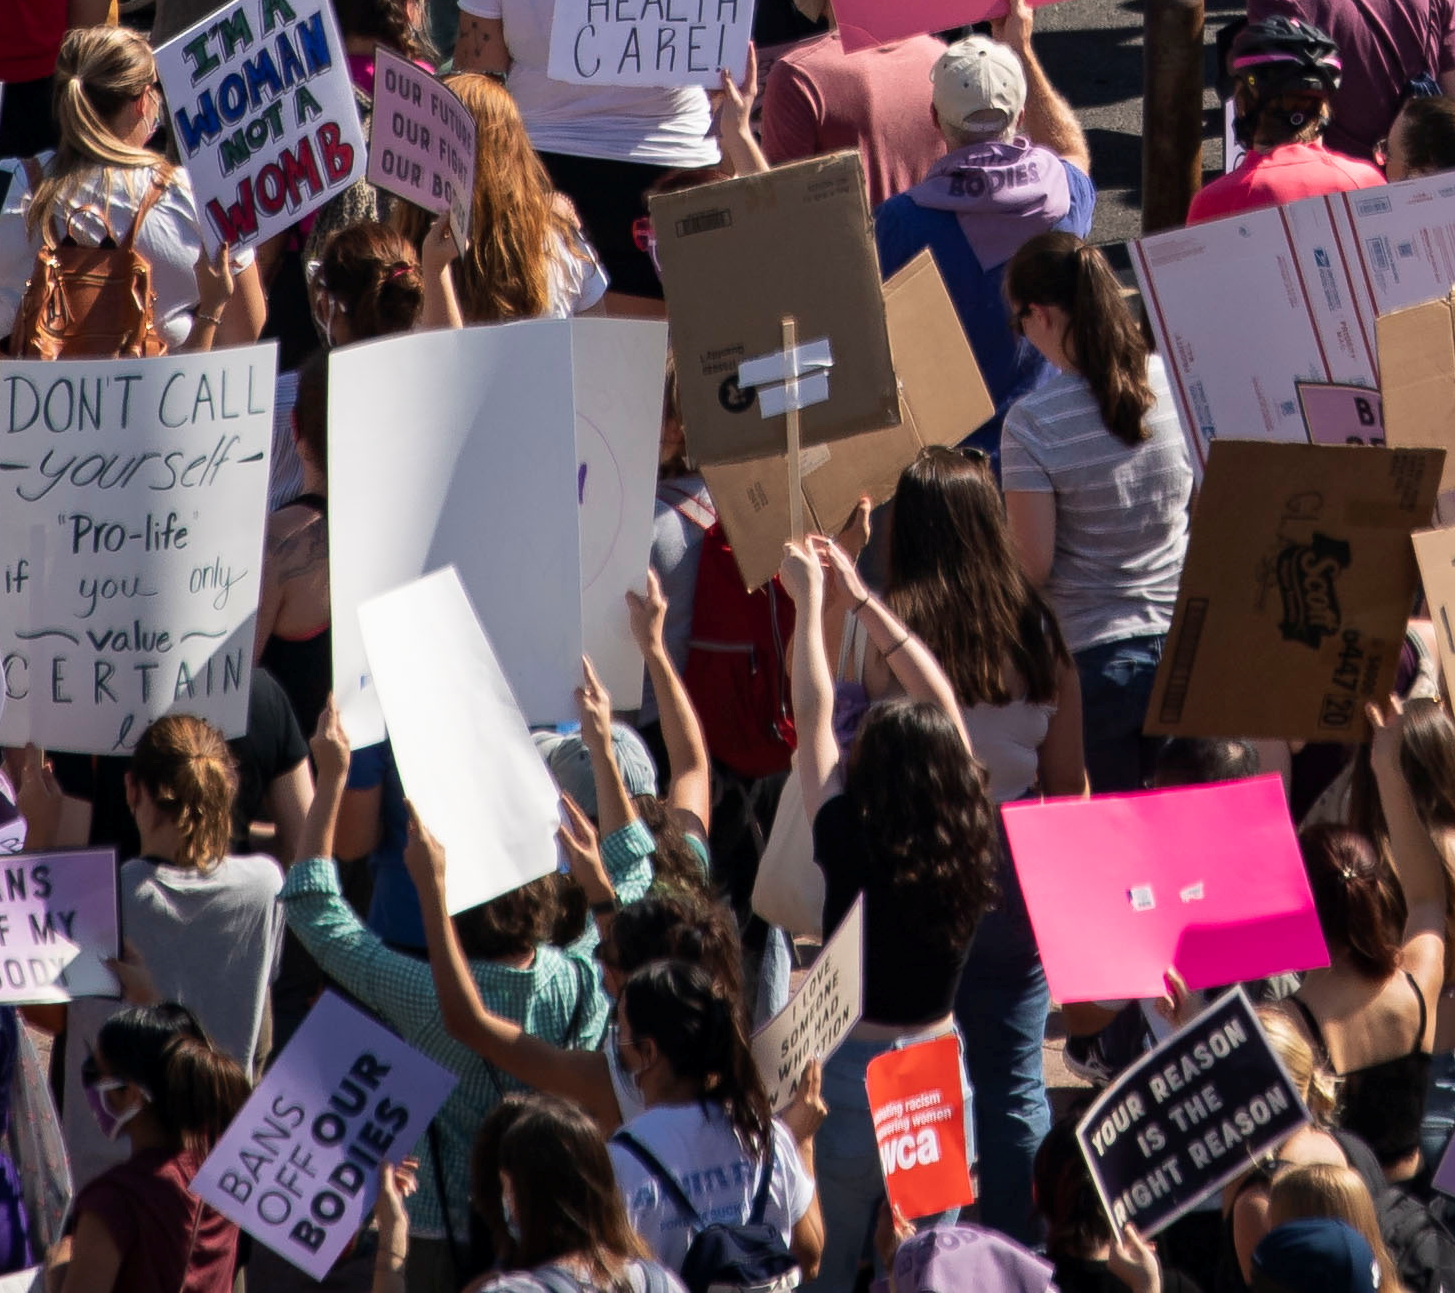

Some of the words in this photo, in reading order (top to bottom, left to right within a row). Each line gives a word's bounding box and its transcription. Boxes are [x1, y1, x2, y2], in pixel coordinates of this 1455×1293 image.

[175, 10, 332, 158] WOMAN
[182, 7, 255, 87] I'M
[573, 25, 727, 76] CARE!
[219, 113, 286, 177] NOT
[294, 89, 324, 125] A
[205, 121, 355, 247] WOMB
